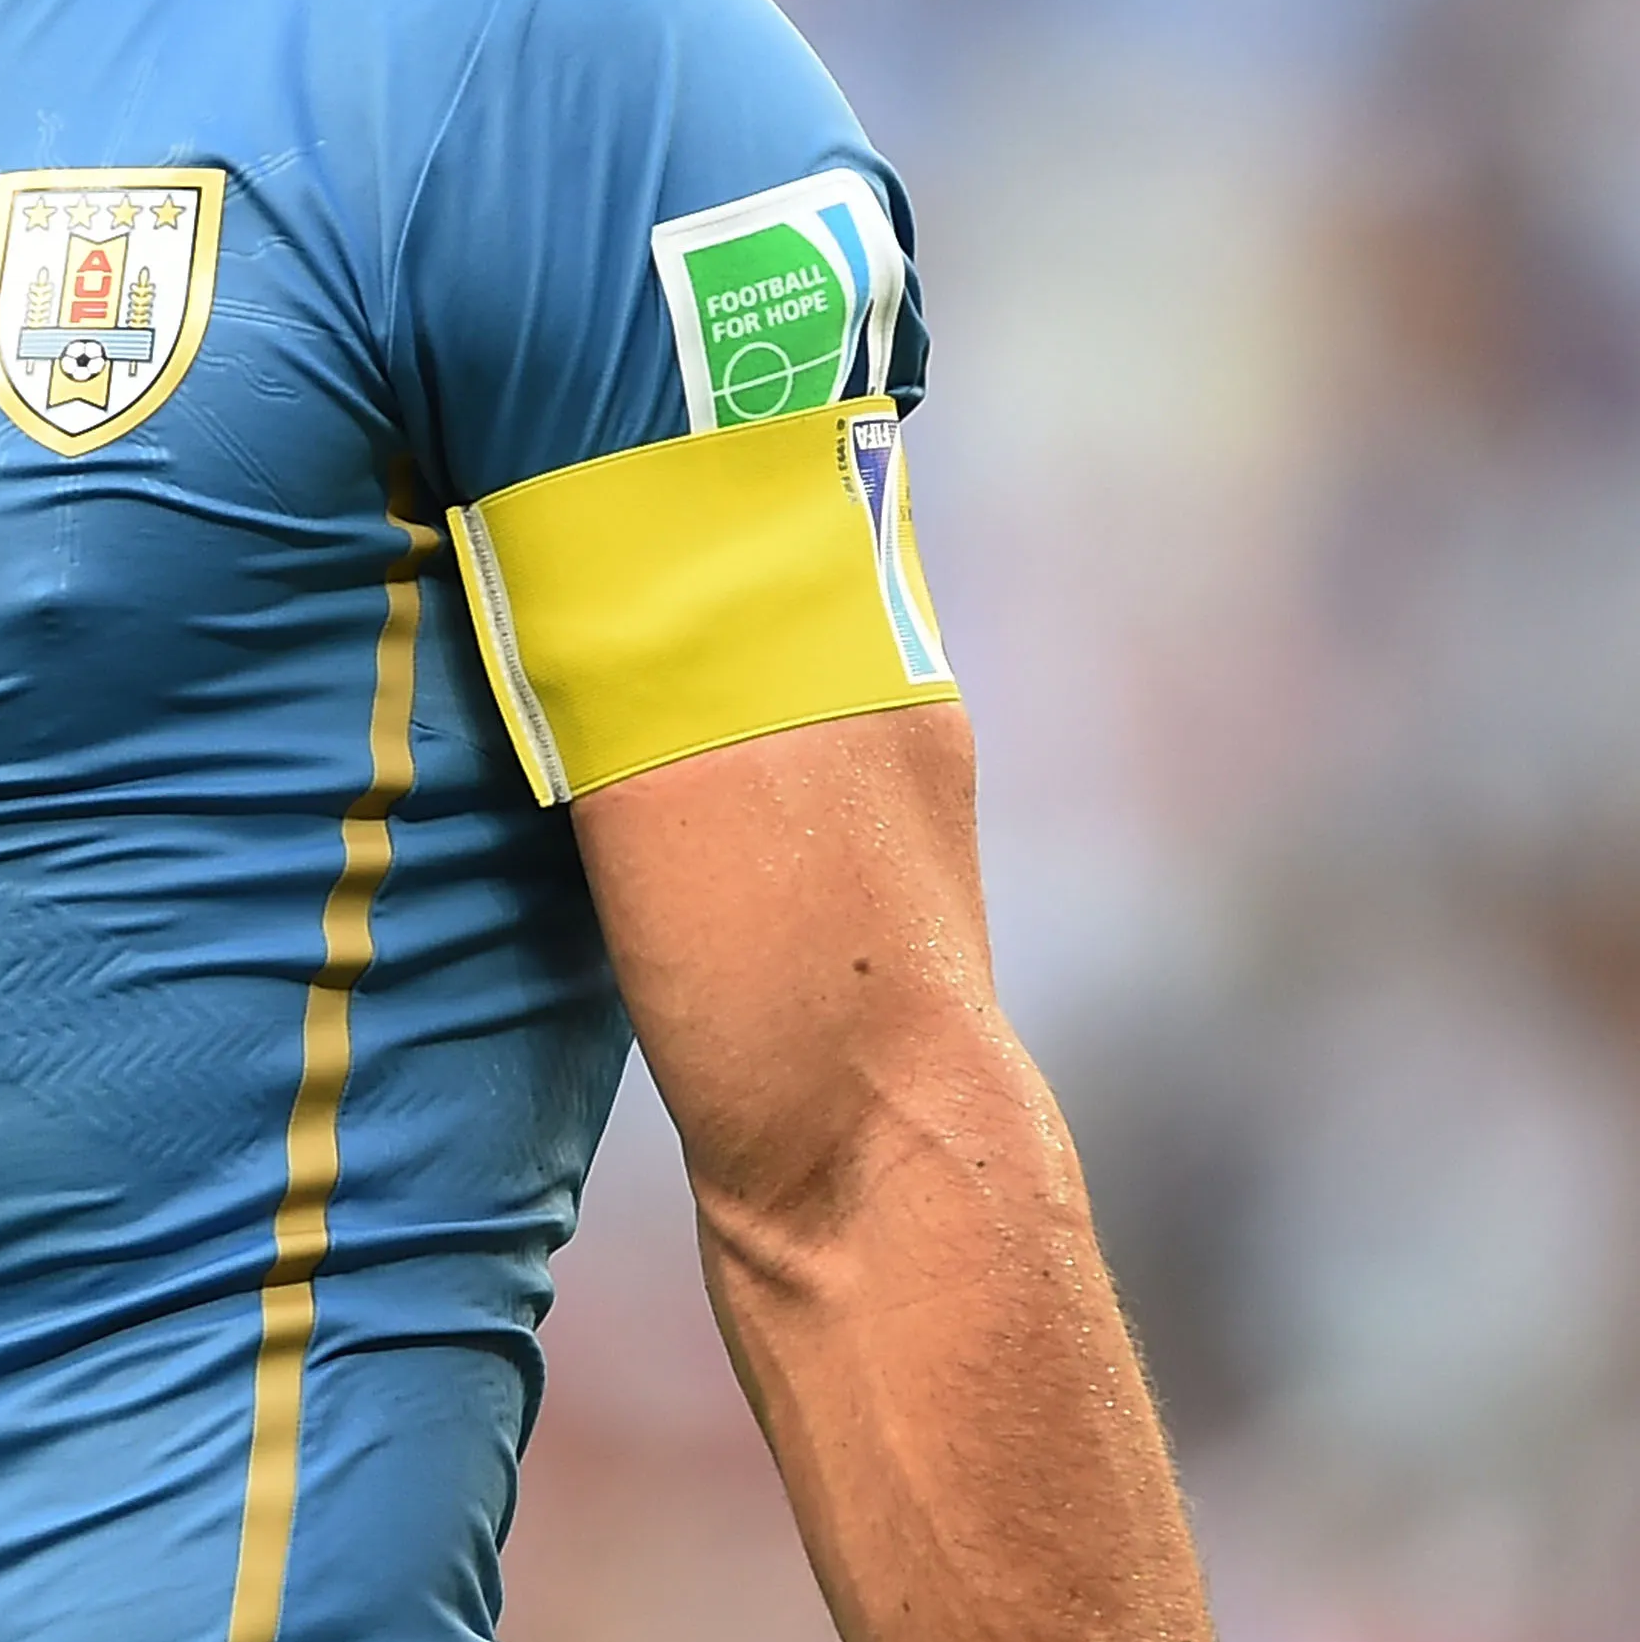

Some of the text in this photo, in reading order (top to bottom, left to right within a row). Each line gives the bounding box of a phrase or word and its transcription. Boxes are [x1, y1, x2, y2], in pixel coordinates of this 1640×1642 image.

[70, 250, 113, 323] AUF
[706, 263, 828, 318] FOOTBALL
[712, 289, 829, 343] FOR HOPE
